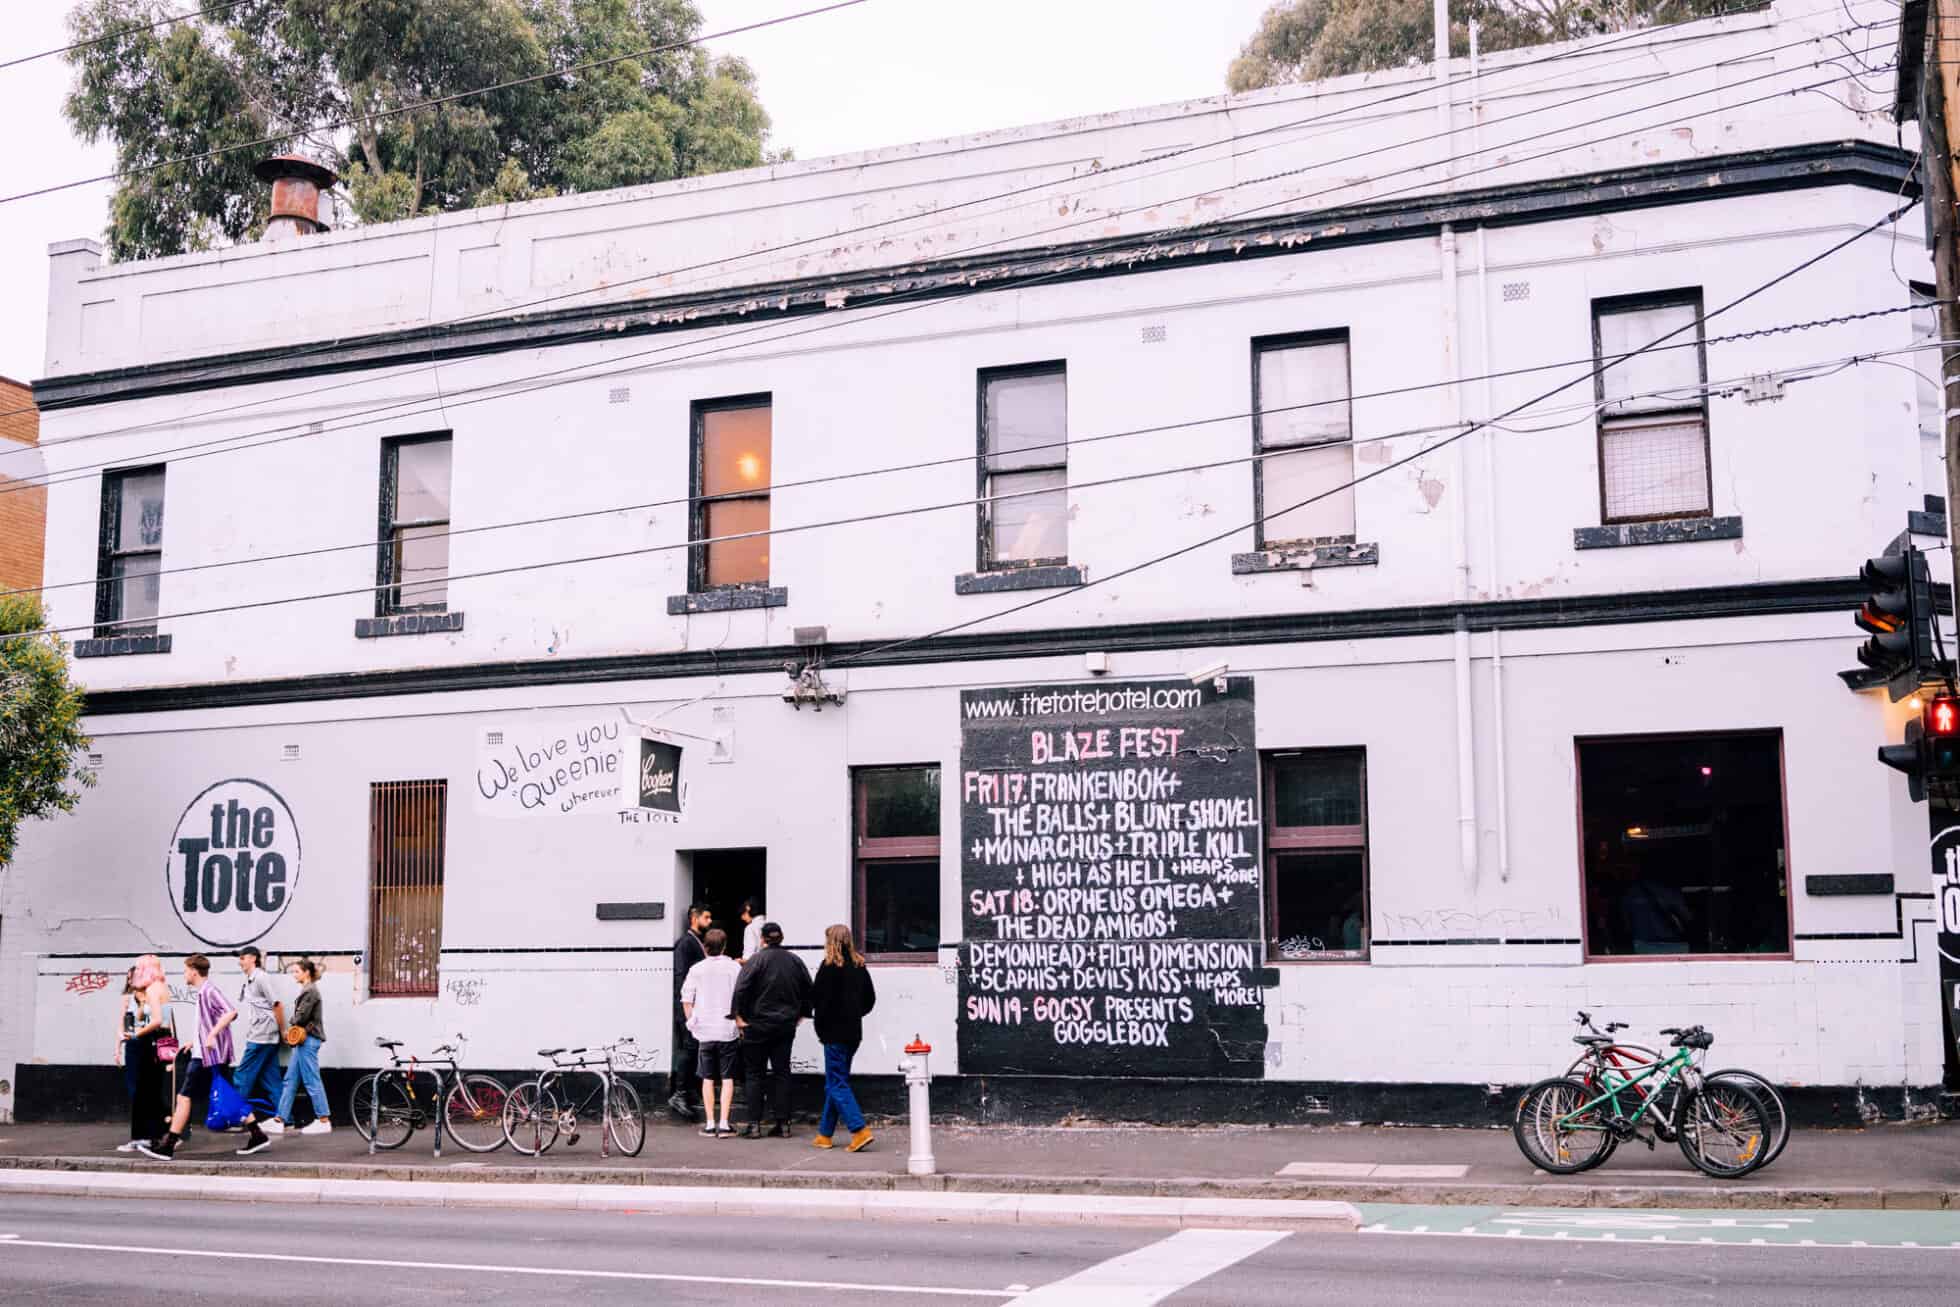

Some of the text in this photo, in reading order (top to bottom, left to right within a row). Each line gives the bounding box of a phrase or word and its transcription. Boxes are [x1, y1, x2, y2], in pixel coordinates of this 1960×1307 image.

[965, 687, 1201, 719] www.thetotehotel.com
[476, 720, 619, 799] We love you
[1031, 727, 1184, 765] BLAZE FEST
[210, 800, 275, 850] the
[618, 811, 640, 824] THE
[987, 803, 1033, 837] THE
[1115, 801, 1186, 832] BLUNT
[1185, 796, 1259, 831] SHOVEL
[1206, 830, 1253, 859] KILL
[178, 837, 287, 913] Tote
[1031, 864, 1080, 887] HIGH
[1087, 863, 1112, 886] AS
[1116, 860, 1171, 886] HELL
[970, 888, 1010, 916] SAT
[1043, 888, 1136, 916] ORPHEUS
[992, 915, 1035, 939] THE
[1037, 914, 1091, 939] DEAD
[1150, 942, 1253, 972] DIMENSION
[1073, 967, 1133, 993] DEVILS
[1138, 967, 1182, 994] KISS
[967, 995, 1001, 1024] SUN
[1105, 995, 1194, 1023] PRESENTS
[1215, 985, 1262, 1010] MORE!
[1054, 1020, 1169, 1047] GOGGLEBOX
